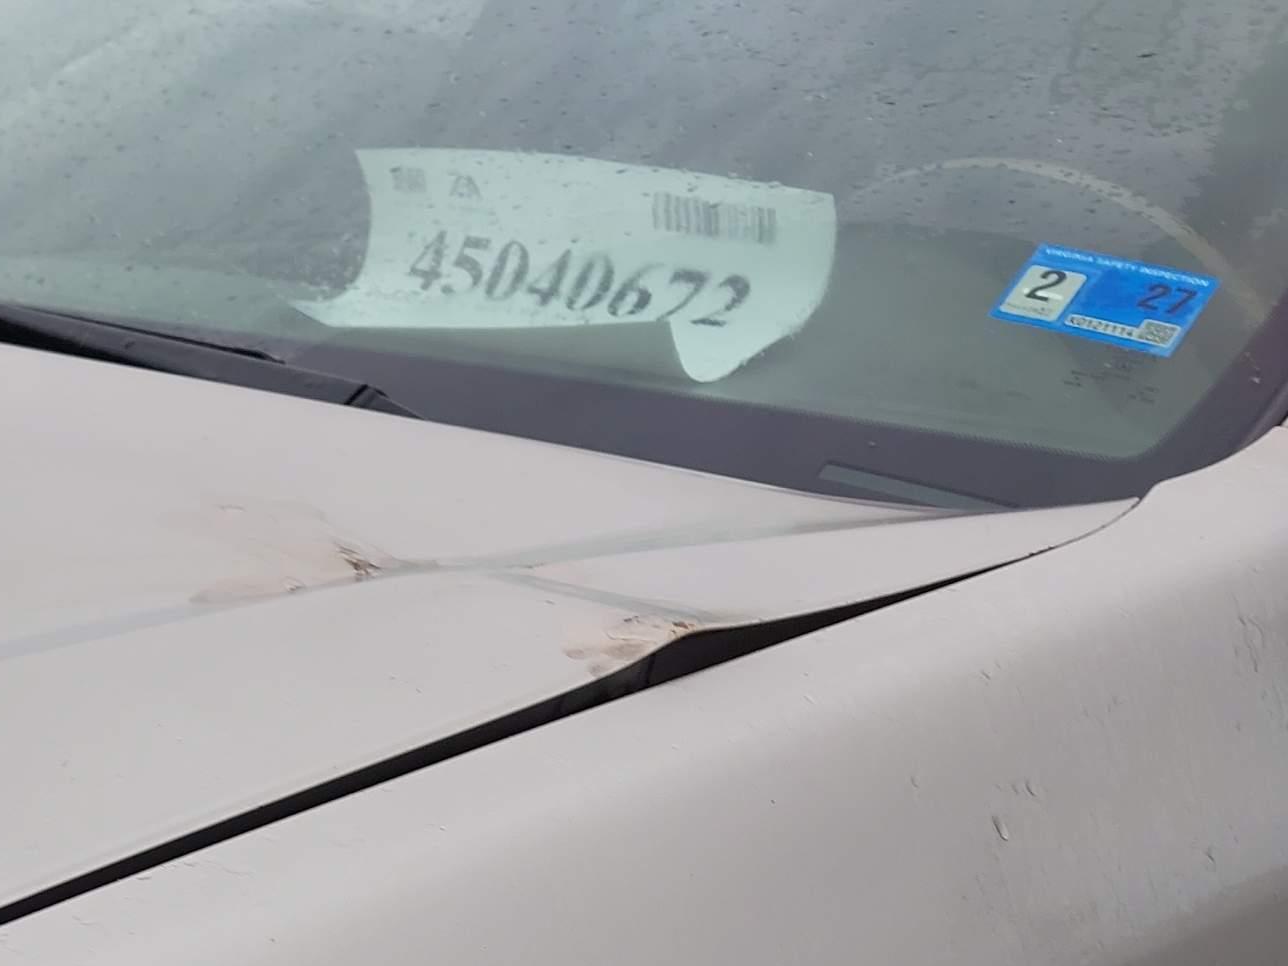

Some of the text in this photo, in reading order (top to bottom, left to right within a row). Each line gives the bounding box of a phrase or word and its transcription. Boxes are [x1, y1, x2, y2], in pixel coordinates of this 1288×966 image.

[407, 230, 752, 328] 45040672
[1046, 248, 1210, 287] VIRGINIA SAFETY INSPECTION
[1024, 270, 1067, 302] 2
[1137, 284, 1198, 315] 27
